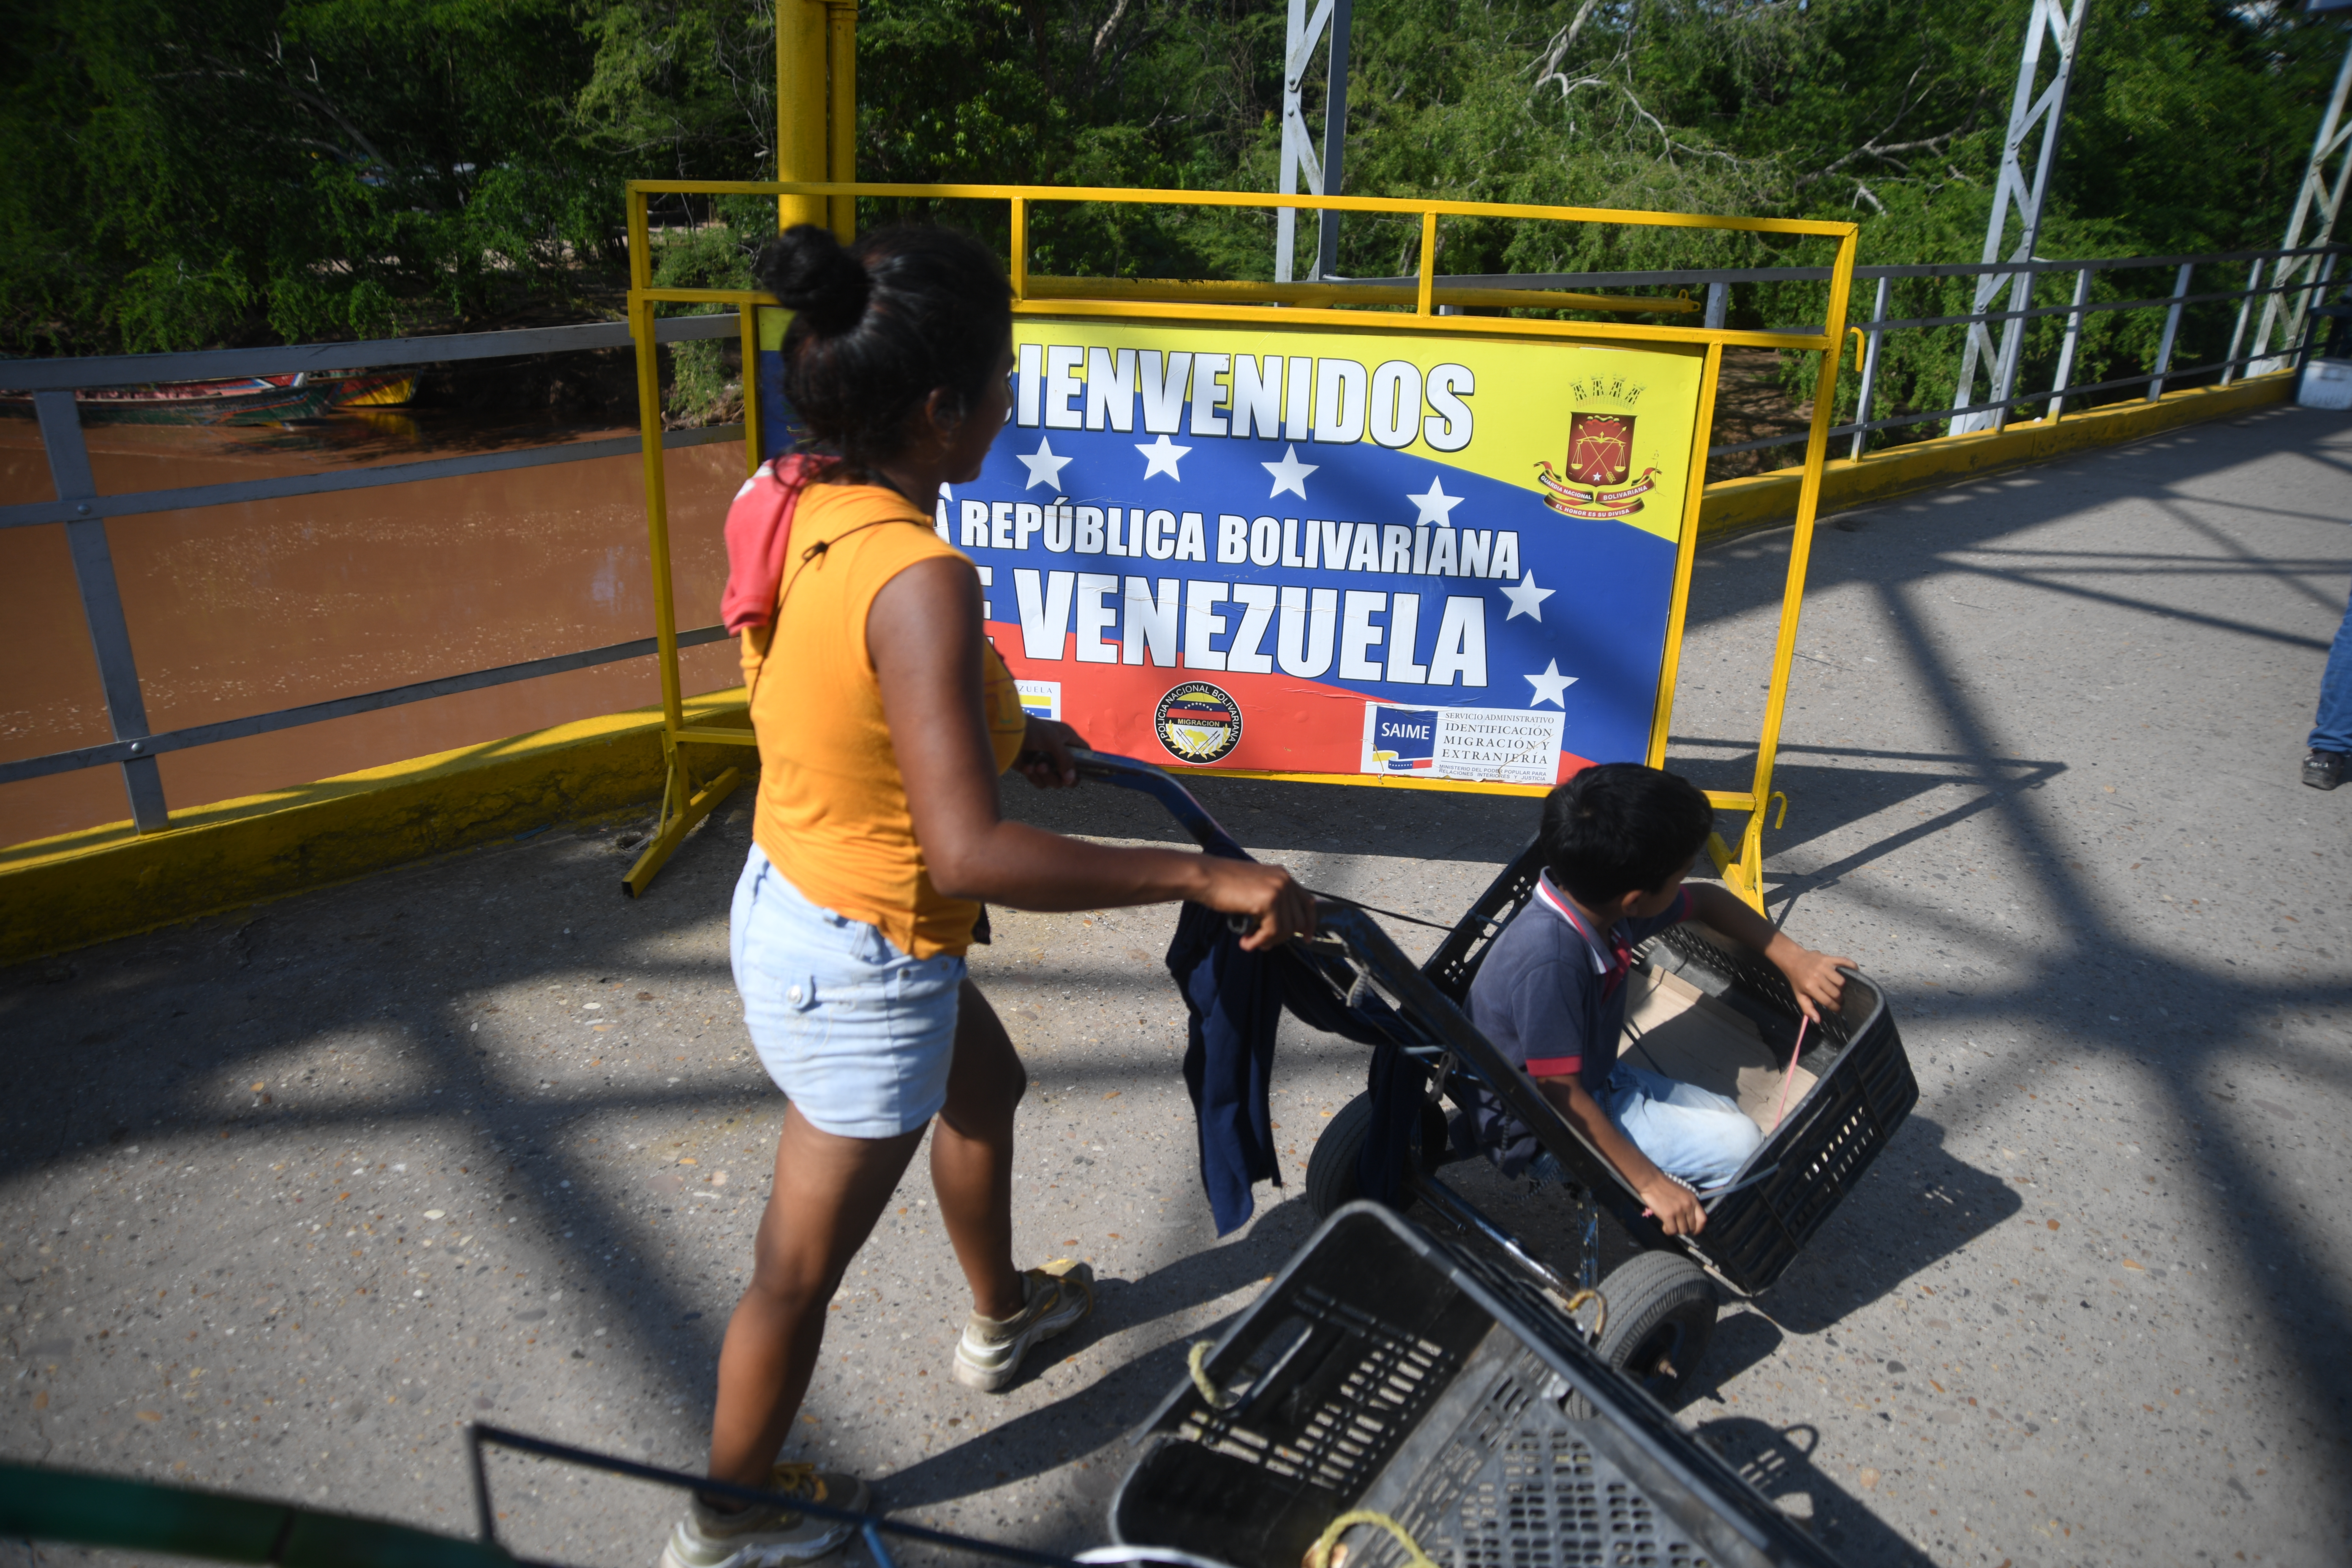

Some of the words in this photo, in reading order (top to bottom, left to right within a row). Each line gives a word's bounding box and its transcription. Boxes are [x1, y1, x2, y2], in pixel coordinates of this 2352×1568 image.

[1004, 343, 1475, 453] IENVENIDOS
[1540, 475, 1563, 492] GUARDIA
[1563, 489, 1592, 500] NACIONAL
[1603, 485, 1648, 500] BOLIVARIANA
[1564, 507, 1587, 516] HONOR
[1608, 508, 1630, 517] DIVISA
[960, 496, 1207, 562] REPÚBLICA
[1216, 514, 1520, 580] BOLIVARIANA
[1013, 568, 1488, 687] VENEZUELA
[1016, 685, 1052, 694] ZUELA
[1157, 704, 1169, 739] POLICIA
[1165, 684, 1210, 704] NACIONAL
[1211, 689, 1239, 742] BOLIVARIANA
[1485, 714, 1554, 724] ADMINISTRATIVO
[1178, 719, 1220, 727] MIGRACION
[1445, 723, 1552, 737] IDENTIFICACIÓN
[1381, 722, 1430, 740] SAIME
[1443, 735, 1537, 749] MIGRACIÓN
[1542, 742, 1551, 750] Y
[1442, 749, 1548, 764] EXTRANJERÍA
[1439, 768, 1473, 776] RELACIONES
